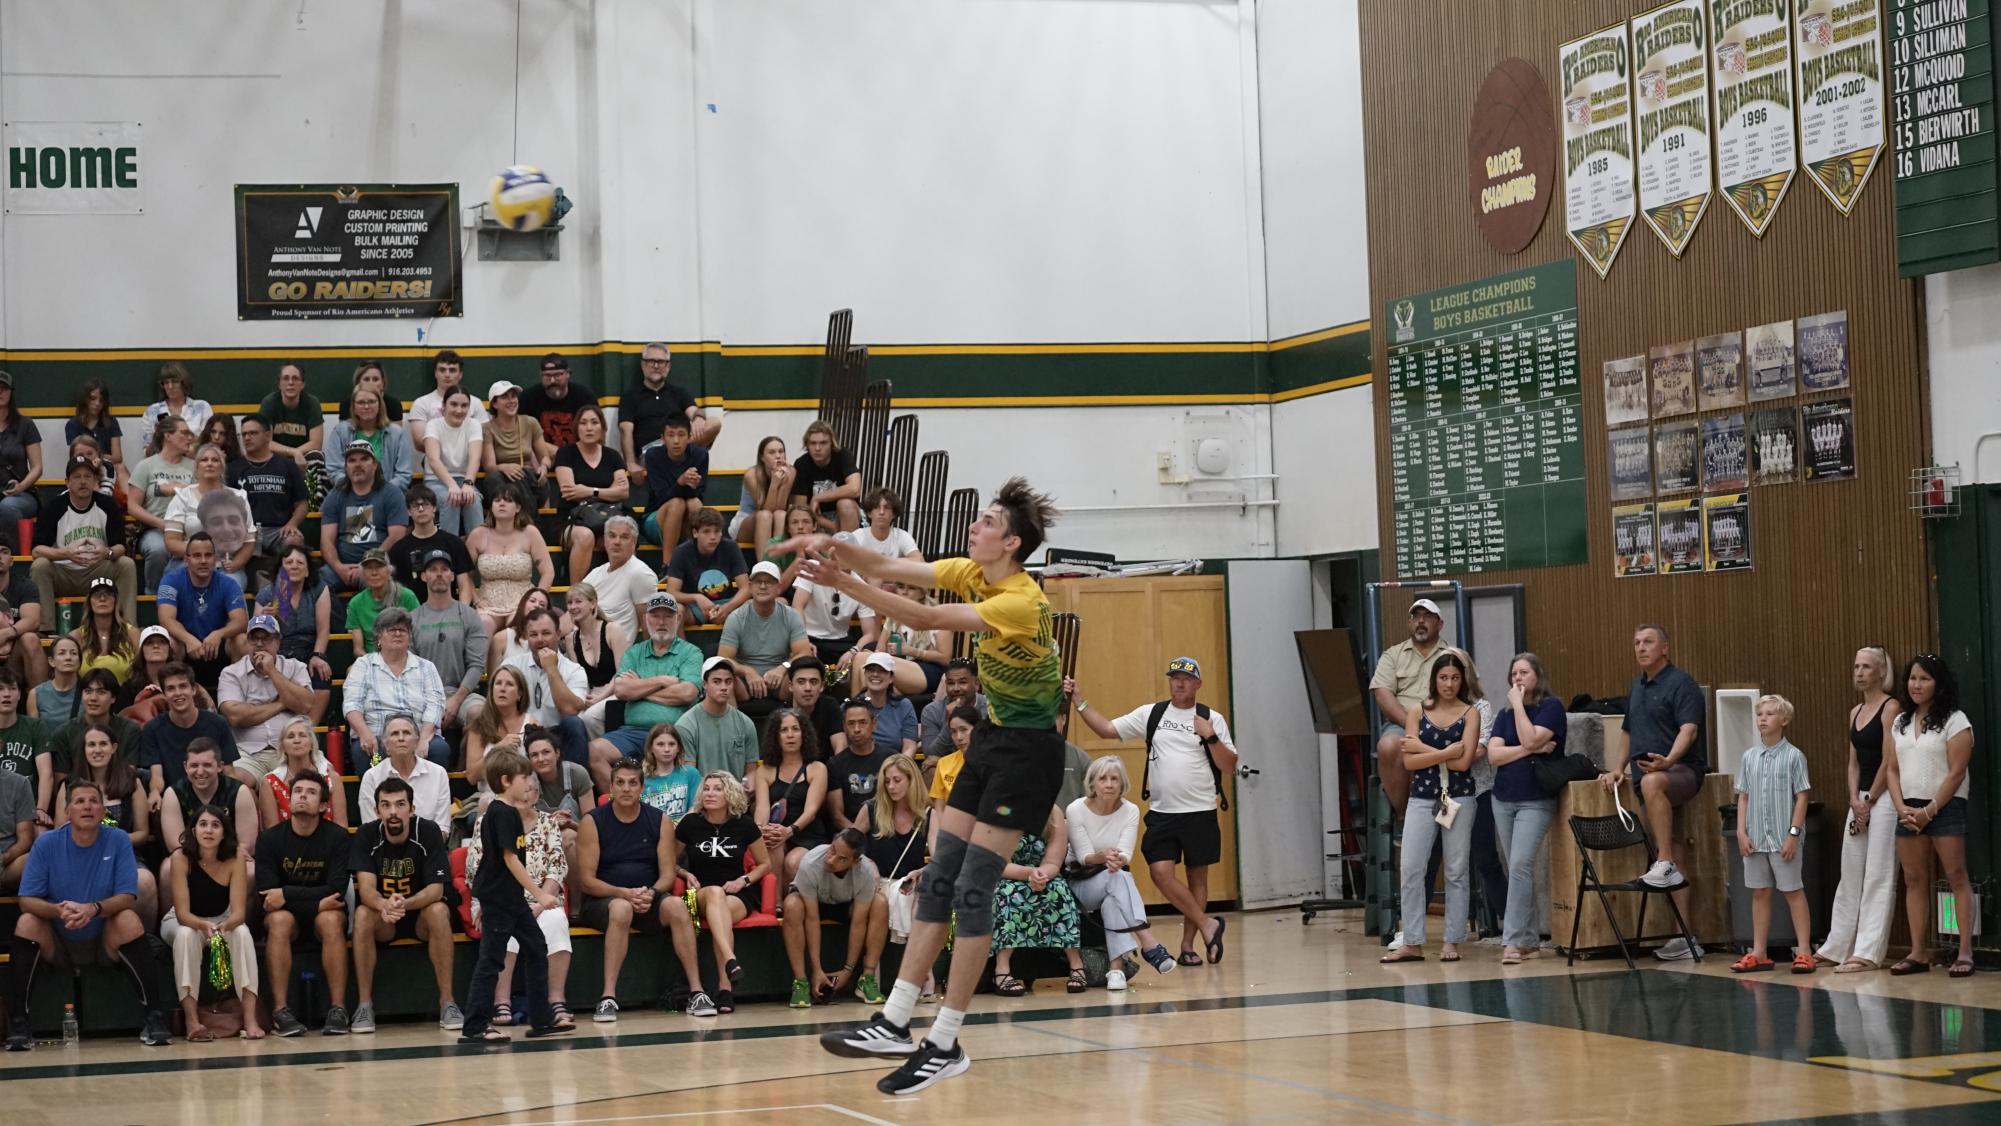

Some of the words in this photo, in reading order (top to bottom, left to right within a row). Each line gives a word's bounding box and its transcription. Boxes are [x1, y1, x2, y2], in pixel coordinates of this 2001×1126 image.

[1896, 11, 1905, 36] 9
[1913, 0, 1967, 32] SULLIVAN
[1647, 23, 1692, 57] RAIDERS
[1894, 38, 1909, 66] 10
[1914, 23, 1966, 60] SILLIMAN
[1573, 53, 1615, 85] RAIDERS
[1801, 56, 1823, 104] BOYS
[1824, 39, 1879, 82] BASKETBALL
[1894, 66, 1909, 93] 12
[1915, 53, 1965, 89] MCQUOID
[1718, 84, 1738, 130] BOYS
[1738, 69, 1790, 111] BASKETBALL
[1816, 78, 1866, 106] 2001-2002
[1896, 94, 1911, 122] 13
[1916, 82, 1962, 117] MCCARL
[1640, 110, 1660, 156] BOYS
[1659, 96, 1706, 136] BASKETBALL
[1742, 108, 1767, 128] 1996
[1896, 123, 1913, 150] 15
[1918, 107, 1980, 145] BIERWIRTH
[1567, 134, 1585, 178] BOYS
[1585, 122, 1630, 160] BASKETBALL
[1663, 133, 1685, 152] 1991
[10, 147, 137, 188] HOME
[1486, 146, 1523, 179] RAIDER
[1588, 158, 1608, 176] 1985
[1897, 151, 1913, 178] 16
[1920, 140, 1960, 173] VIDANA
[1482, 173, 1536, 214] CHAMPIONS
[344, 223, 382, 233] CUSTOM
[386, 222, 428, 233] PRINTING
[348, 210, 388, 220] GRAPHIC
[390, 210, 423, 220] DESIGN
[354, 236, 378, 246] BULK
[381, 236, 418, 246] MAILING
[360, 249, 388, 259] SINCE
[390, 249, 414, 259] 2005
[268, 268, 378, 278] AnthonyVanNoteDesigns@gmail.com
[388, 267, 432, 276] 916.203.4953
[268, 281, 308, 300] GO
[314, 280, 432, 300] RAIDERS!
[1430, 291, 1470, 312] LEAGUE
[1472, 276, 1536, 302] CHAMPIONS
[294, 309, 322, 318] Sponsor
[344, 308, 383, 316] Americano
[384, 307, 414, 315] Athletics
[1434, 312, 1462, 330] BOYS
[1464, 296, 1534, 323] BASKETBALL
[248, 476, 285, 484] TOTTENHAM
[91, 577, 113, 588] RIO
[62, 610, 71, 619] G
[6, 742, 32, 760] POLY
[383, 878, 410, 898] 55
